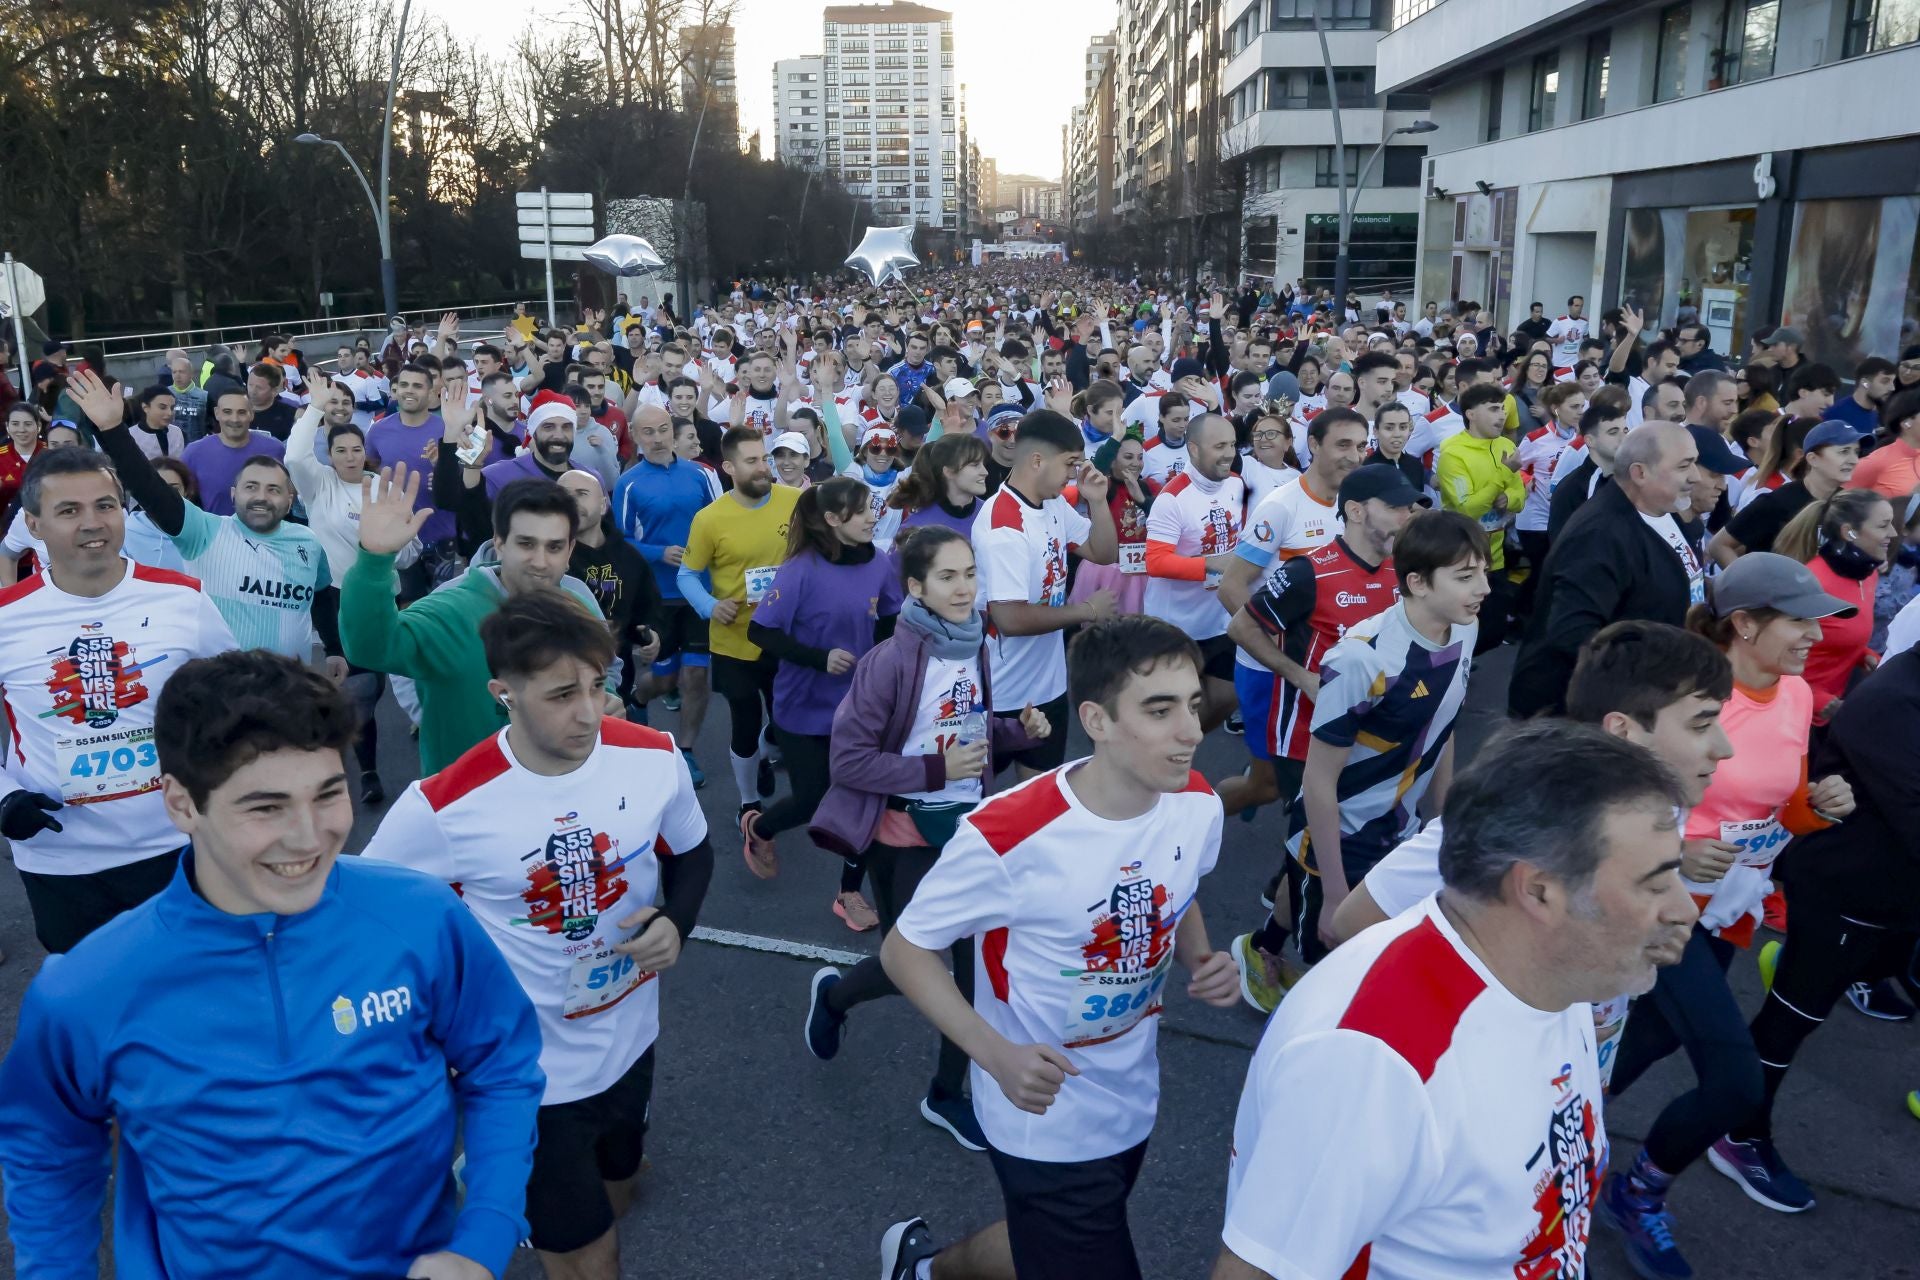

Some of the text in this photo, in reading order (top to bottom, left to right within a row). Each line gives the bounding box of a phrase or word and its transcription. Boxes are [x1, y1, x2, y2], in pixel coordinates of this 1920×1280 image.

[1353, 214, 1391, 223] Asistencial
[1215, 524, 1228, 536] SIL
[239, 575, 313, 602] JALISCO
[271, 601, 300, 610] MÉXICO
[89, 638, 113, 651] 55
[76, 647, 112, 663] SAN
[79, 661, 113, 679] SIL
[81, 676, 115, 694] VES
[961, 680, 971, 692] 55
[80, 691, 118, 711] TRE
[955, 701, 971, 715] SIL
[949, 719, 962, 727] SAN
[75, 738, 89, 746] 55
[89, 734, 110, 745] SAN
[111, 727, 154, 741] SILVESTR
[70, 743, 158, 778] 4703
[1741, 823, 1754, 831] 55
[566, 829, 593, 850] 55
[554, 846, 594, 866] SAN
[559, 861, 595, 885] SIL
[561, 877, 597, 900] VES
[1129, 880, 1153, 903] 55
[560, 893, 599, 917] TRE
[1117, 899, 1153, 920] SAN
[1120, 916, 1152, 941] SIL
[595, 950, 608, 960] 55
[1120, 934, 1152, 957] VES
[1114, 952, 1150, 973] TRE
[1099, 976, 1114, 985] 55
[1114, 976, 1139, 985] SAN
[1563, 1098, 1584, 1141] 55
[1556, 1131, 1589, 1176] SAN
[1561, 1163, 1590, 1214] SIL
